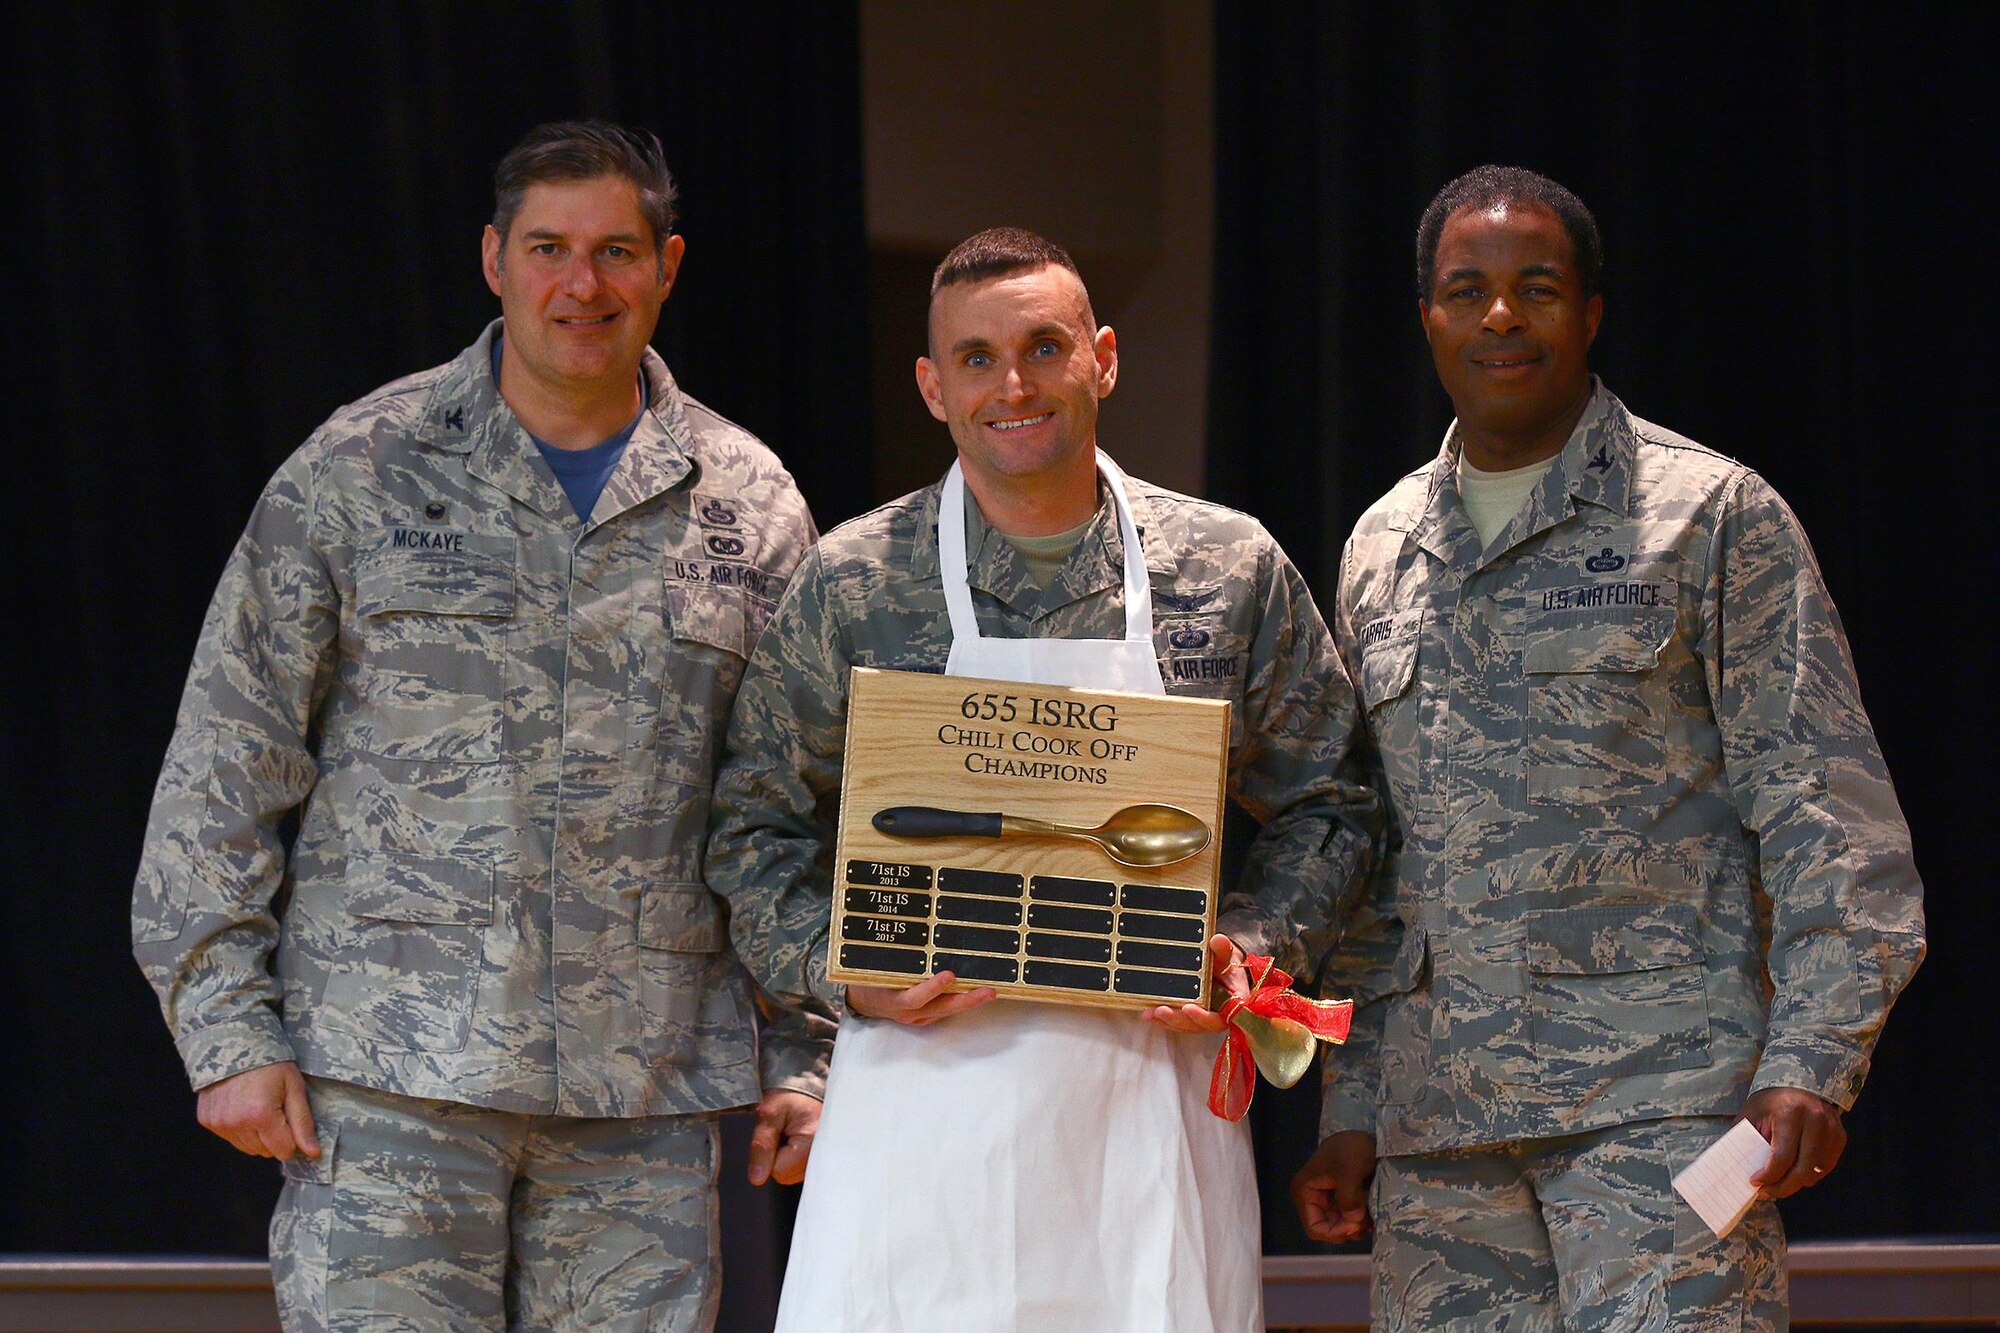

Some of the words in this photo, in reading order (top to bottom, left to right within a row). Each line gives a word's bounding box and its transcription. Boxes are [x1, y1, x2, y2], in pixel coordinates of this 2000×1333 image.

[393, 529, 463, 552] MCKAYE
[675, 561, 704, 581] U.S.
[710, 565, 731, 584] AIR
[737, 567, 768, 596] FORCE
[1542, 589, 1572, 612] U.S.
[1576, 586, 1602, 607] AIR
[1606, 580, 1660, 607] FORCE
[1173, 659, 1200, 681] AIR
[1201, 655, 1239, 679] FORCE
[961, 692, 1018, 723] 655
[1027, 697, 1119, 732] ISRG
[937, 724, 1005, 749] CHILI
[1012, 731, 1082, 757] COOK
[1089, 738, 1139, 762] OFF
[964, 752, 1108, 785] CHAMPIONS
[870, 863, 895, 876] 71st
[897, 865, 910, 878] IS
[879, 876, 900, 887] 2013
[869, 891, 894, 904] 71st
[895, 893, 909, 906] IS
[877, 904, 898, 914] 2014
[866, 919, 891, 933] 71st
[893, 921, 907, 934] IS
[875, 932, 895, 943] 2015
